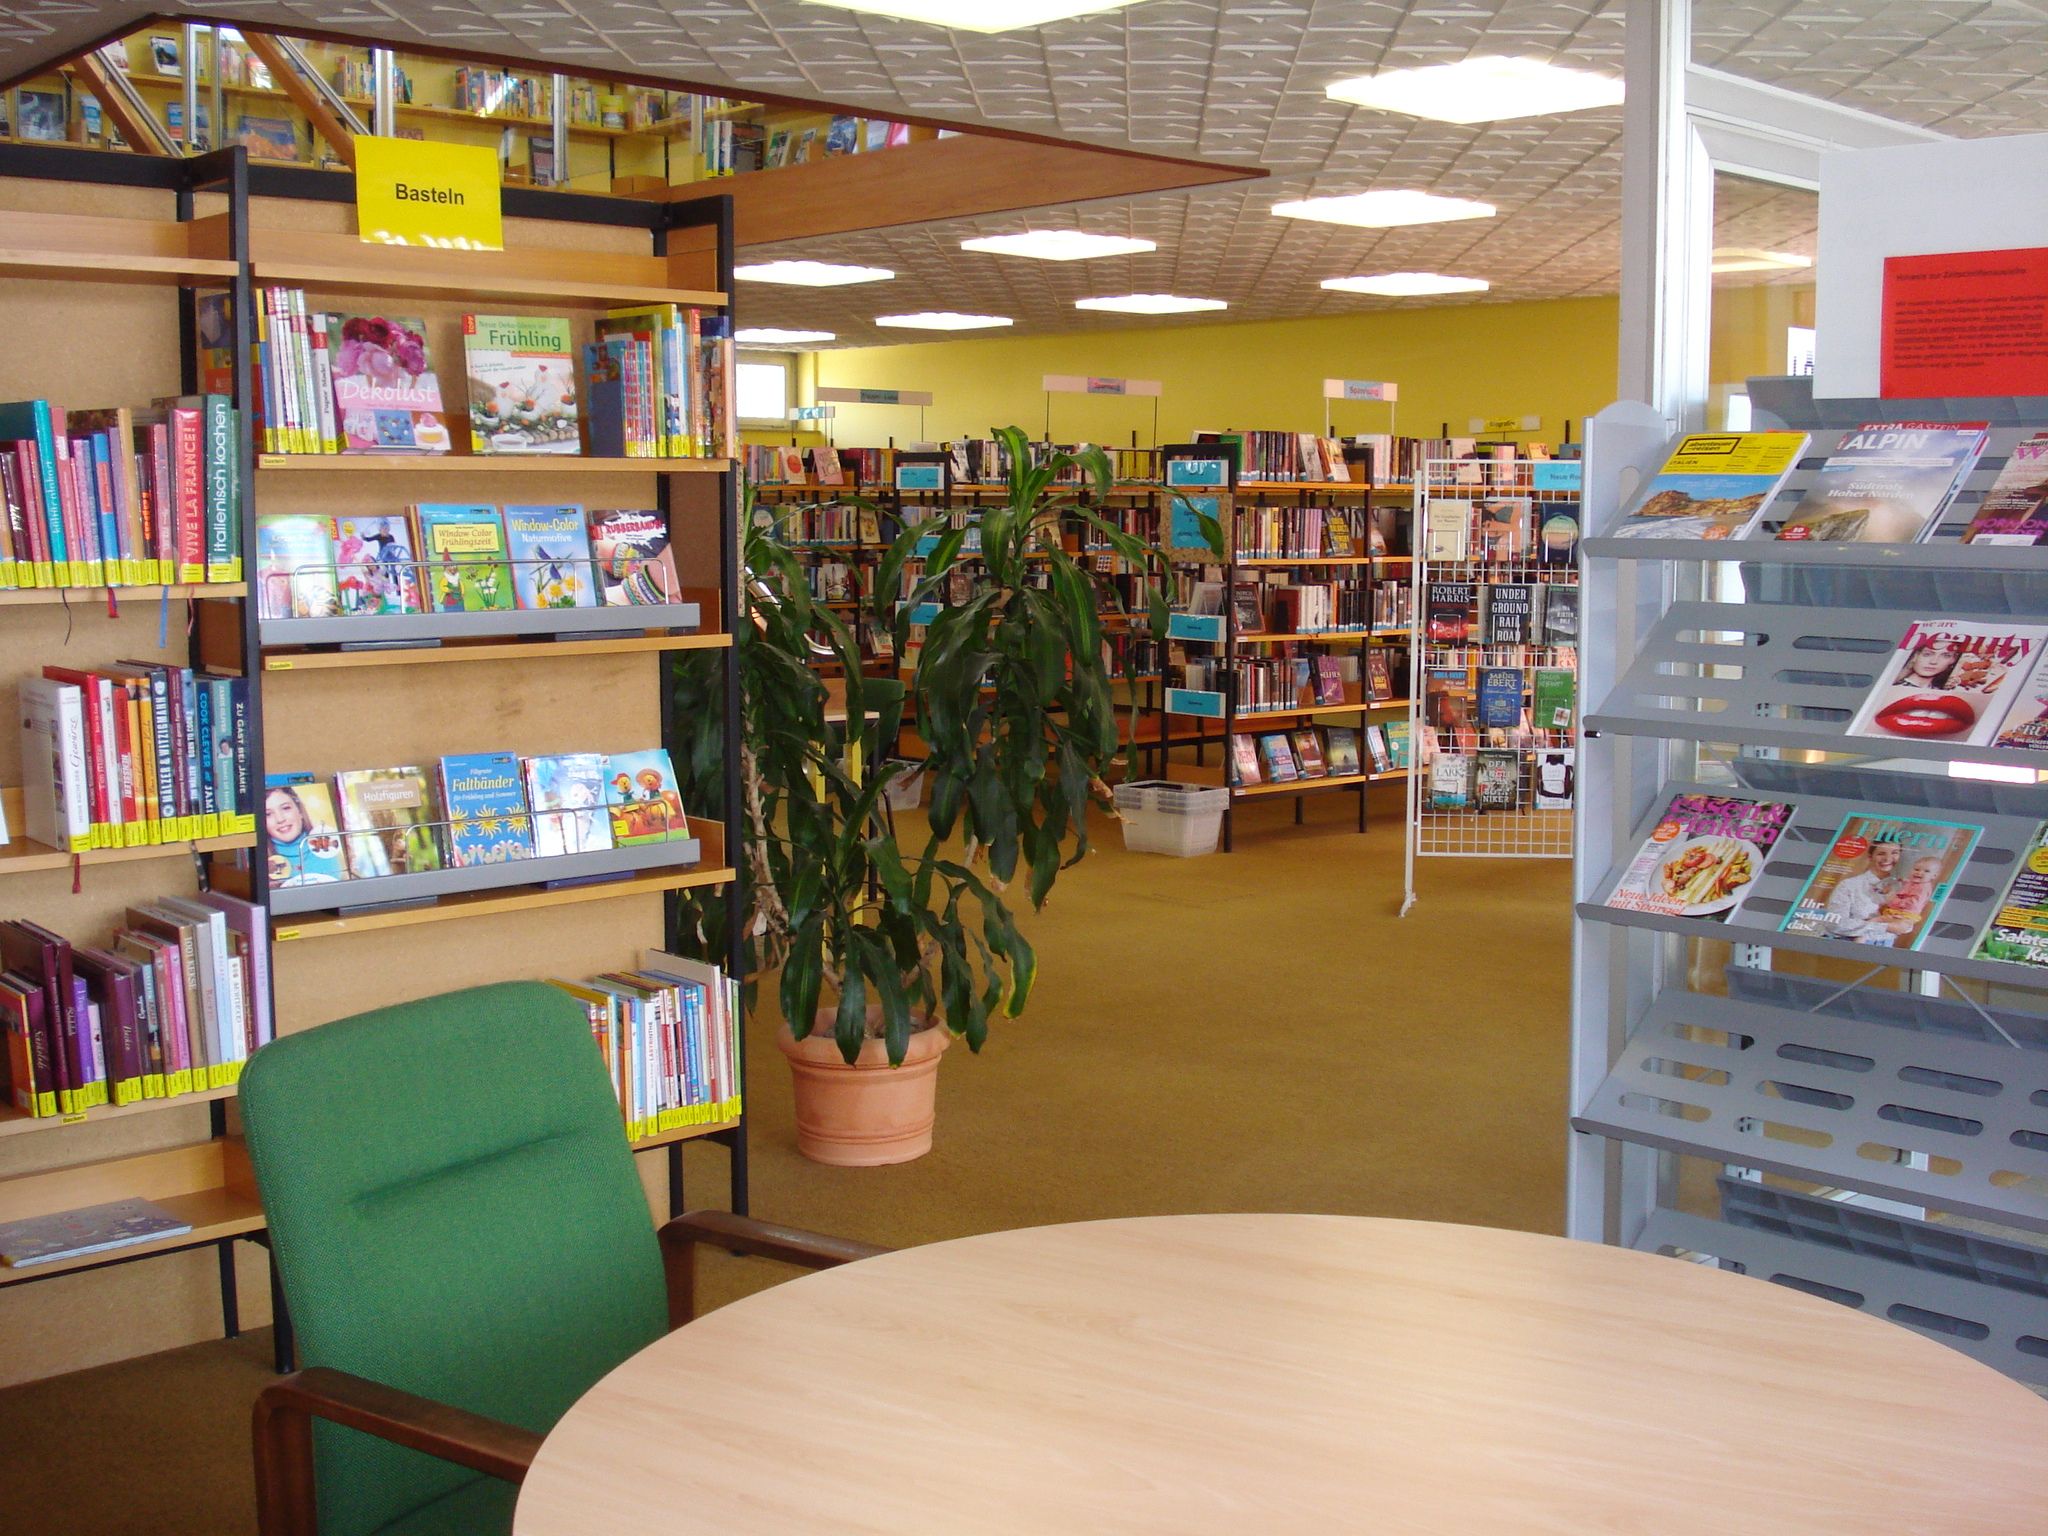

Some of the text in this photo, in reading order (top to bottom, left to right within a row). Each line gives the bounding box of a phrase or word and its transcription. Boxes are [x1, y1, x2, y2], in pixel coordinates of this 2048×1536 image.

[395, 182, 465, 206] Basteln
[489, 329, 563, 352] Frühling
[342, 376, 436, 402] Dekolust
[1843, 433, 1929, 450] ALPIN
[213, 402, 227, 552] italienisch kochen
[1847, 480, 1905, 491] Südtirols
[185, 426, 198, 557] VIVE LA FRANCE!
[1827, 488, 1915, 499] Hoher Norden
[511, 516, 579, 532] Window-Color
[471, 529, 492, 537] Color
[521, 532, 573, 543] Naturmotive
[1432, 586, 1470, 594] ROBERT
[1432, 594, 1470, 603] HARRIS
[1495, 588, 1527, 600] UNDER
[1492, 602, 1529, 614] GROUND
[1898, 623, 2042, 667] beauty
[1487, 679, 1518, 689] EBERT
[199, 692, 210, 726] COOK
[154, 696, 173, 803] MÄLZER & WITZIGMANN
[200, 727, 212, 768] CLEVER
[235, 702, 247, 794] ZU GAST BEI JAMIE
[452, 775, 515, 793] Faltbänder
[204, 785, 214, 813] JAMI
[363, 789, 414, 803] Holzfiguren
[1670, 798, 1788, 825] essen &
[1857, 820, 1949, 849] Eltern
[1608, 897, 1631, 909] mit
[1616, 888, 1685, 905] Neue Ideen
[1800, 897, 1825, 909] Ihr
[1787, 919, 1818, 932] das!
[184, 936, 194, 957] 1001
